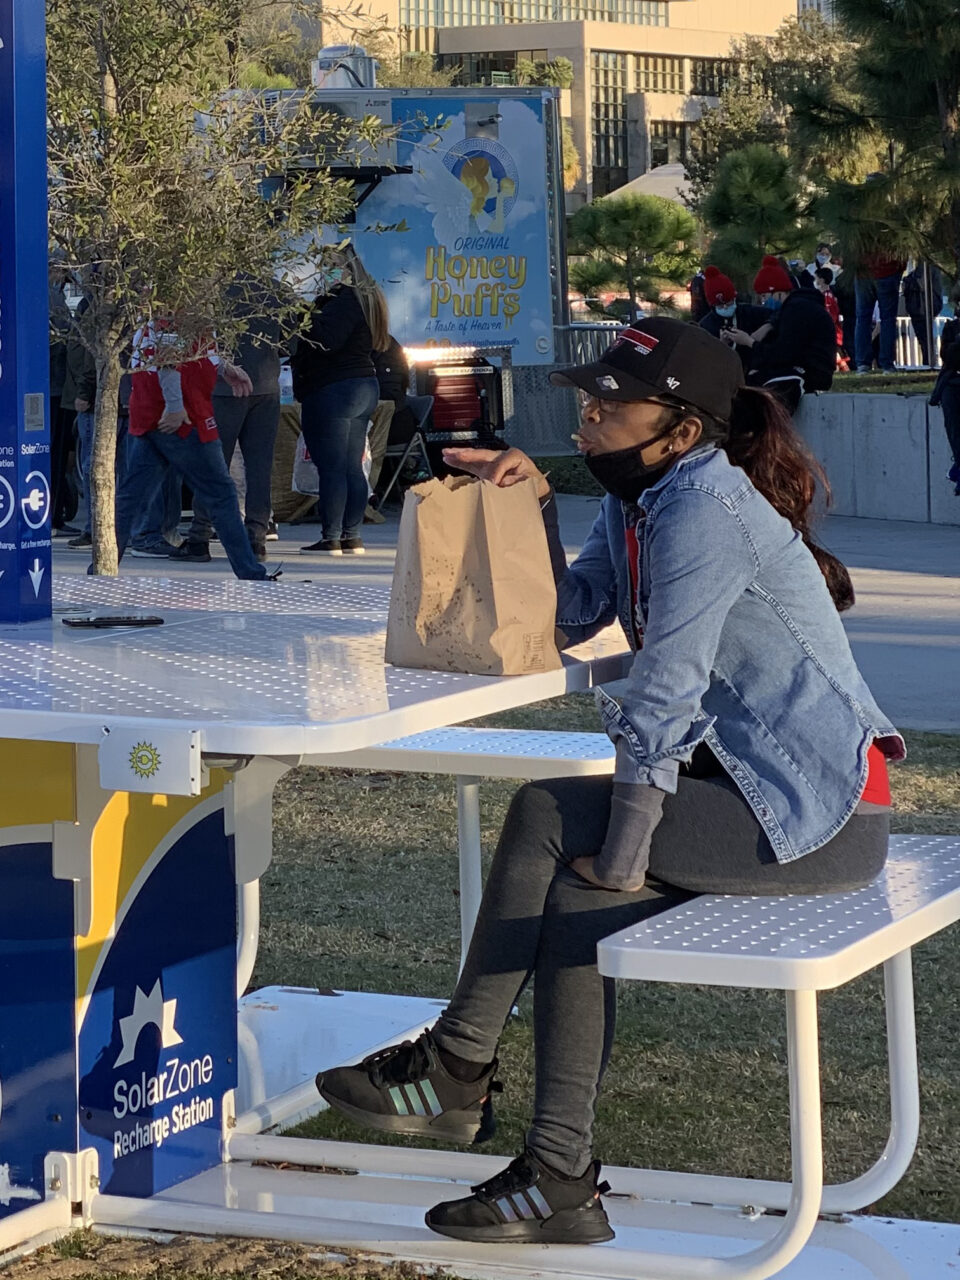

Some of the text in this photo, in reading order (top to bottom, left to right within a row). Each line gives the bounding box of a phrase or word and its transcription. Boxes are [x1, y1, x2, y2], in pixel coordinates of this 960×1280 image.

[454, 235, 511, 252] ORIGINAL
[425, 245, 528, 290] Honey
[430, 282, 521, 319] Puffs
[425, 319, 502, 335] A Taste of Heaven
[21, 443, 50, 455] SolarZone
[113, 1053, 213, 1119] SolarZone
[113, 1095, 214, 1160] Recharge Station
